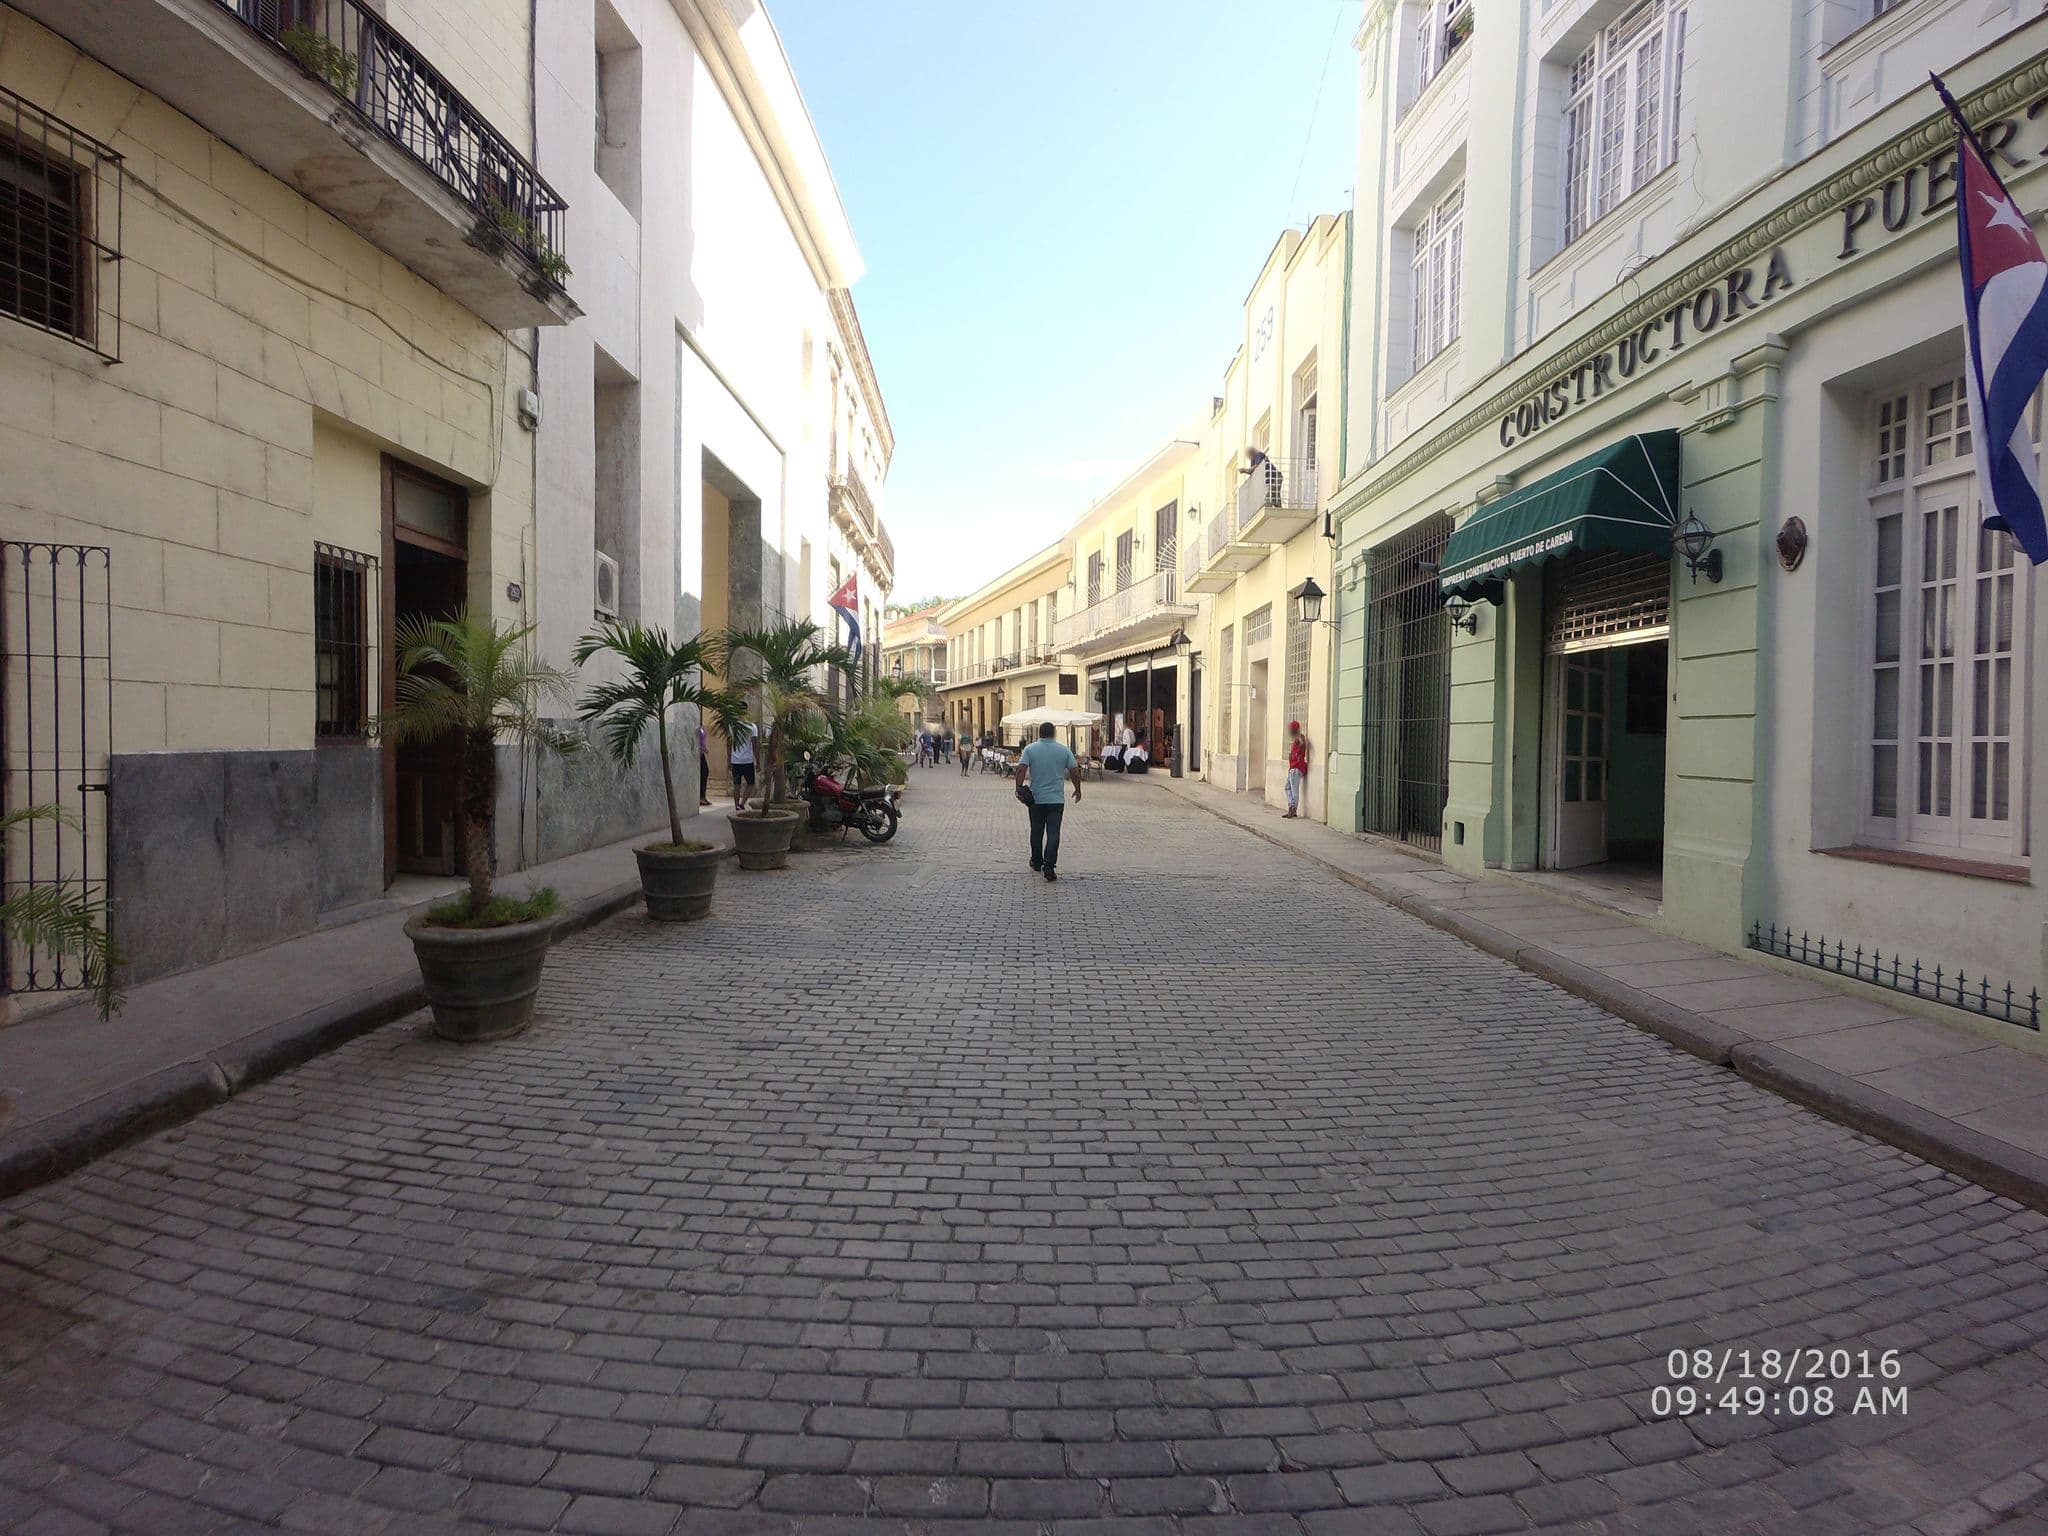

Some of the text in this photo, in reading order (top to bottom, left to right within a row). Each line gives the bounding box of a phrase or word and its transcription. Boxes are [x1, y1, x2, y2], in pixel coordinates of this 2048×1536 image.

[1499, 246, 1793, 448] CONSTRUCTORA
[1466, 554, 1509, 579] CONSTRUCTORA
[1510, 545, 1534, 563] PUERTO
[1535, 540, 1545, 555] DE
[1545, 530, 1573, 550] CARENA
